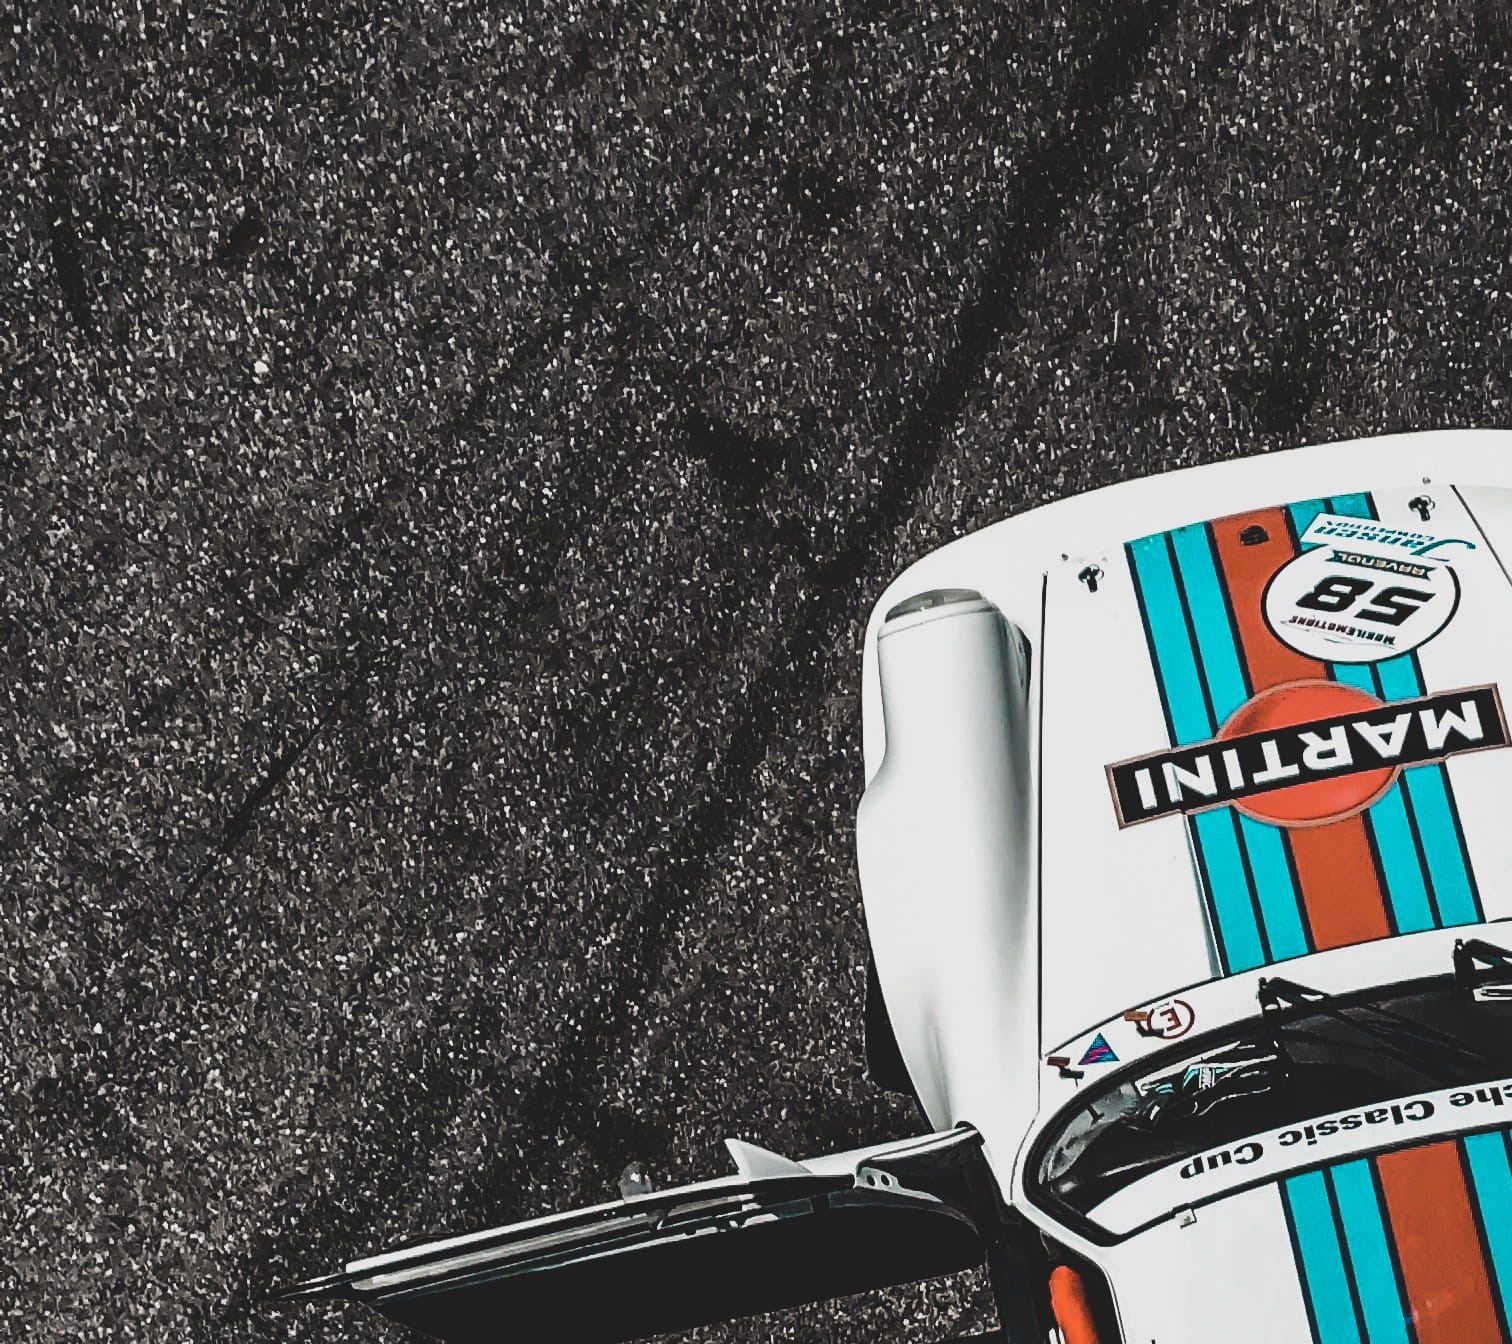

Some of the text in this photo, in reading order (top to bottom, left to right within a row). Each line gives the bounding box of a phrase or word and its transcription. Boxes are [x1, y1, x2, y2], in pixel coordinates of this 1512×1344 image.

[1339, 552, 1425, 576] RAVENOL
[1296, 575, 1436, 626] 58
[1288, 616, 1396, 646] MOBILEMOTIONS
[1134, 700, 1485, 810] MARTINI
[1279, 1104, 1435, 1147] Classic
[1179, 1142, 1265, 1181] Cup
